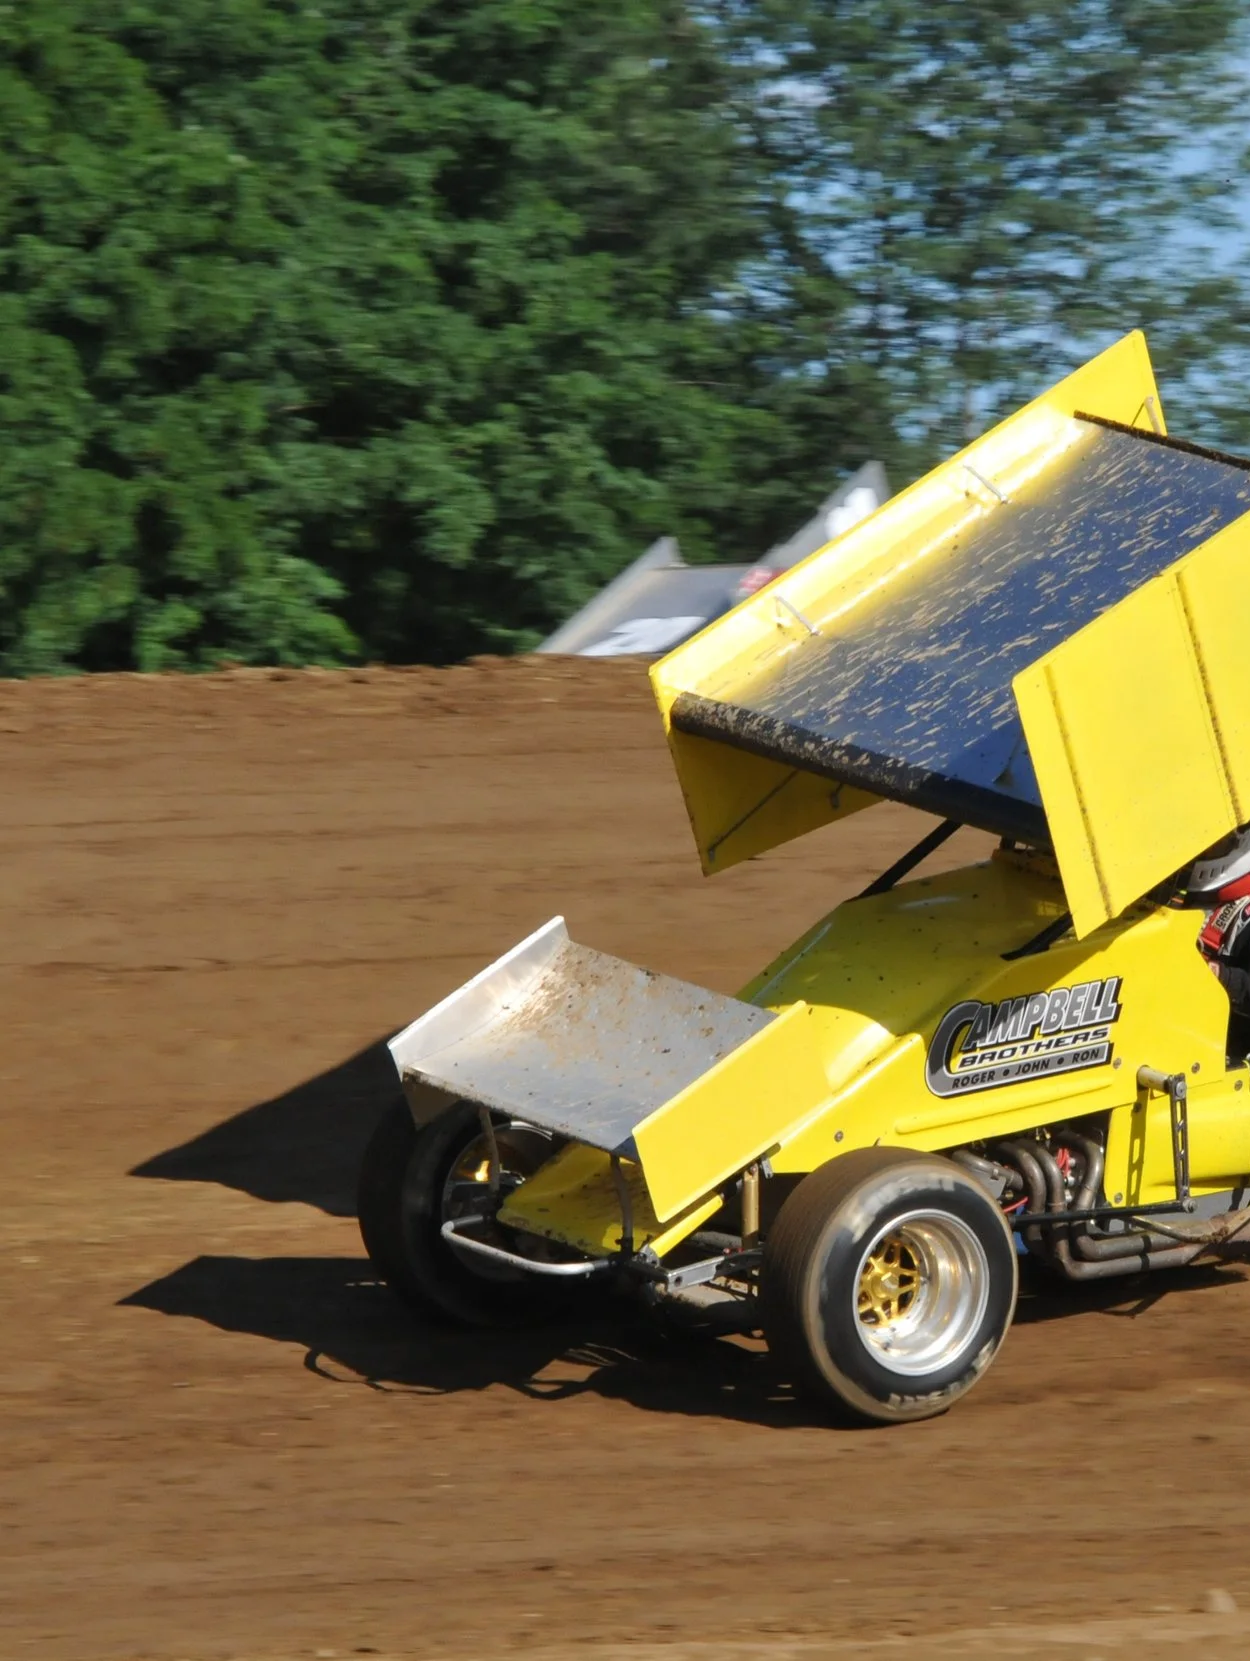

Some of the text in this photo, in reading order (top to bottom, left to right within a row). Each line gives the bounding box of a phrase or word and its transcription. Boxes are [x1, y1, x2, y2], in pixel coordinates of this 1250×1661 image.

[925, 976, 1122, 1098] CAMPBELL
[957, 1027, 1109, 1068] BROTHERS
[952, 1049, 1100, 1089] ROGER JOHN RON
